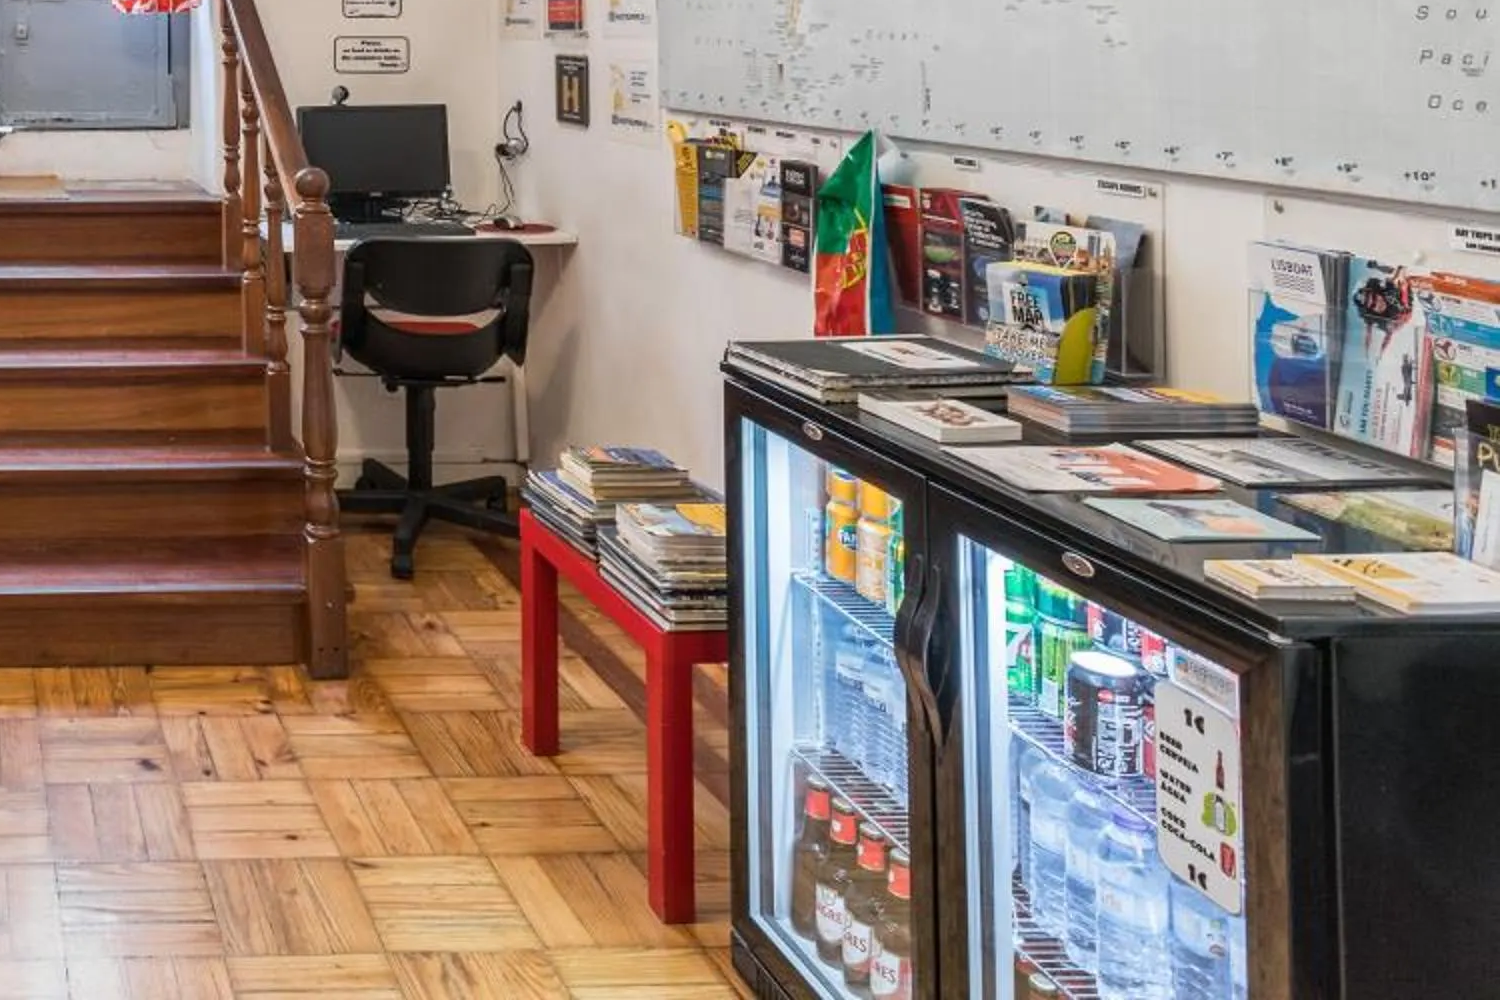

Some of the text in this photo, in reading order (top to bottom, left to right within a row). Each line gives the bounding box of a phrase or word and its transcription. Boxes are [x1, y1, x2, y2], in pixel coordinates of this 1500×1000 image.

[1010, 289, 1039, 305] FREE
[1012, 306, 1044, 325] MAP
[1159, 768, 1192, 795] WATER
[1161, 807, 1186, 829] COKE
[1161, 819, 1216, 862] COCA-COLA
